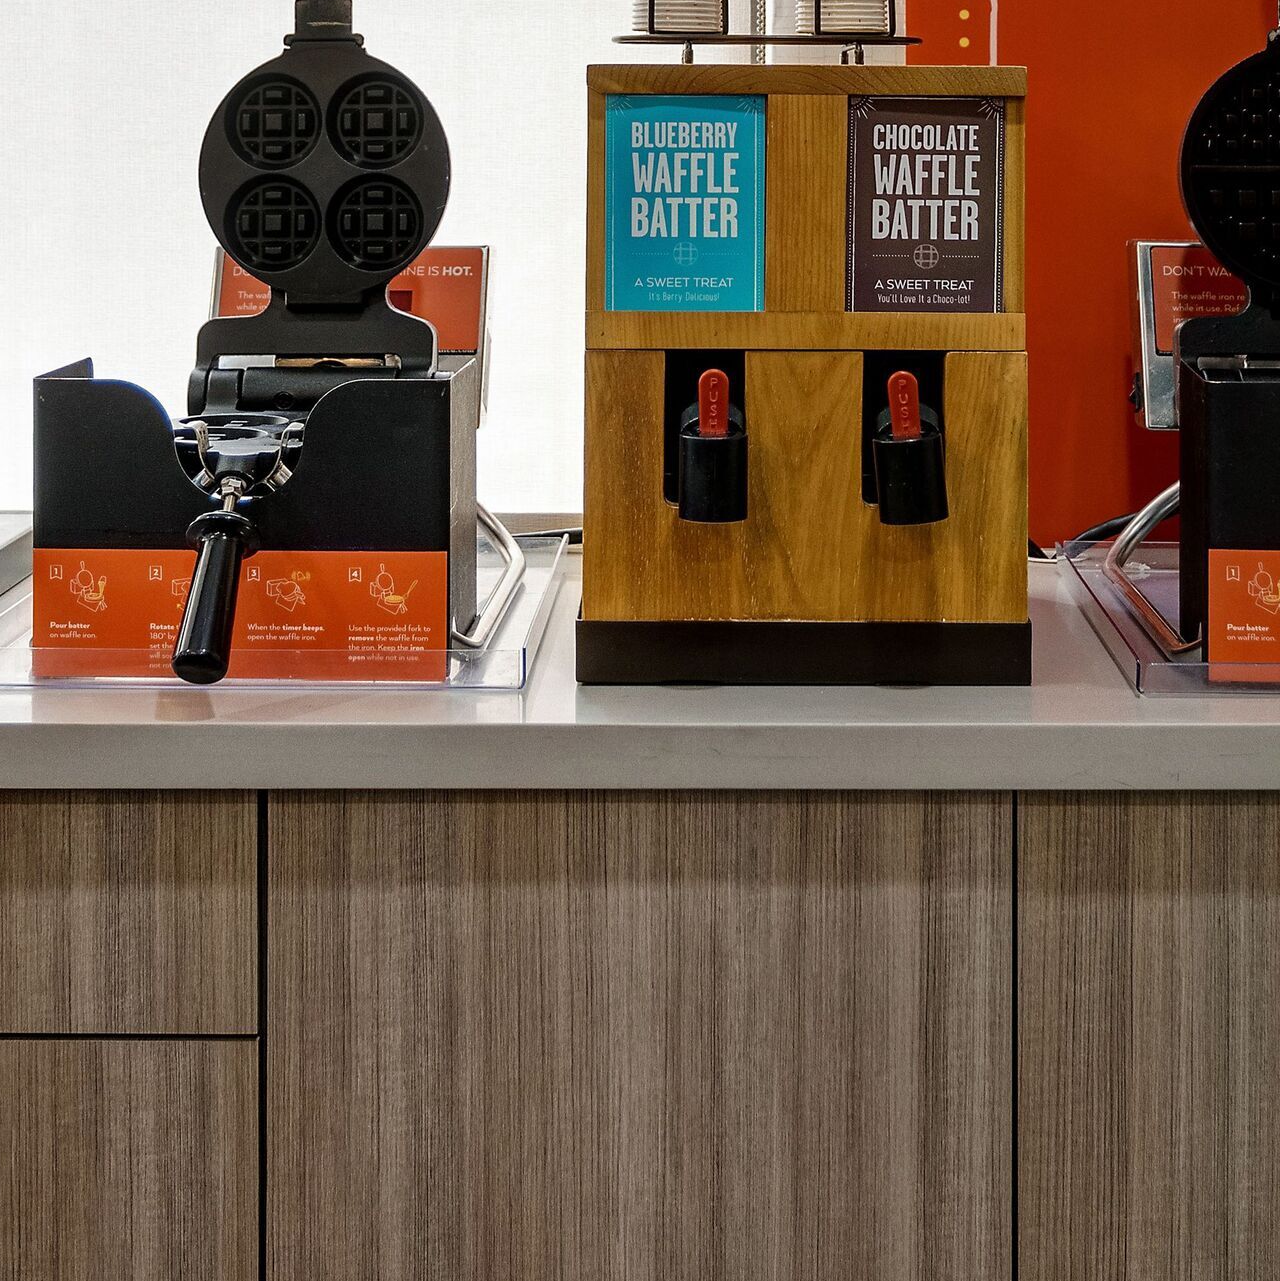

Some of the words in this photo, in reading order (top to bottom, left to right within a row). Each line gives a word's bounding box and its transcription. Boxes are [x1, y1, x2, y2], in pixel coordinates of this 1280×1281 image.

[631, 121, 738, 149] BLUEBERRY
[873, 124, 979, 151] CHOCOLATE
[631, 152, 739, 193] WAFFLE
[873, 154, 981, 196] WAFFLE
[631, 197, 738, 238] BATTER
[872, 199, 979, 241] BATTER
[428, 266, 440, 276] IS
[442, 266, 473, 276] HOT.
[634, 277, 644, 288] A
[646, 277, 690, 288] SWEET
[693, 277, 734, 288] TREAT
[874, 279, 884, 290] A
[886, 279, 929, 290] SWEET
[932, 280, 975, 291] TREAT
[238, 291, 254, 299] The
[662, 291, 682, 304] Berry
[877, 293, 897, 304] You'll
[900, 293, 917, 304] Love
[919, 293, 924, 304] It
[926, 296, 931, 304] a
[932, 293, 970, 305] Choco-lot!
[1171, 291, 1188, 300] The
[1190, 291, 1217, 300] waffle
[236, 302, 257, 310] while
[1172, 303, 1194, 312] while
[1195, 304, 1204, 312] in
[50, 622, 68, 630] Pour
[69, 621, 91, 629] batter
[376, 624, 406, 634] provided
[408, 624, 422, 632] fork
[1246, 624, 1269, 632] batter
[57, 631, 81, 639] waffle
[247, 634, 265, 642] open
[278, 633, 300, 641] waffle
[376, 634, 387, 642] the
[388, 634, 410, 642] waffle
[411, 634, 429, 642] from
[377, 644, 396, 653] Keep
